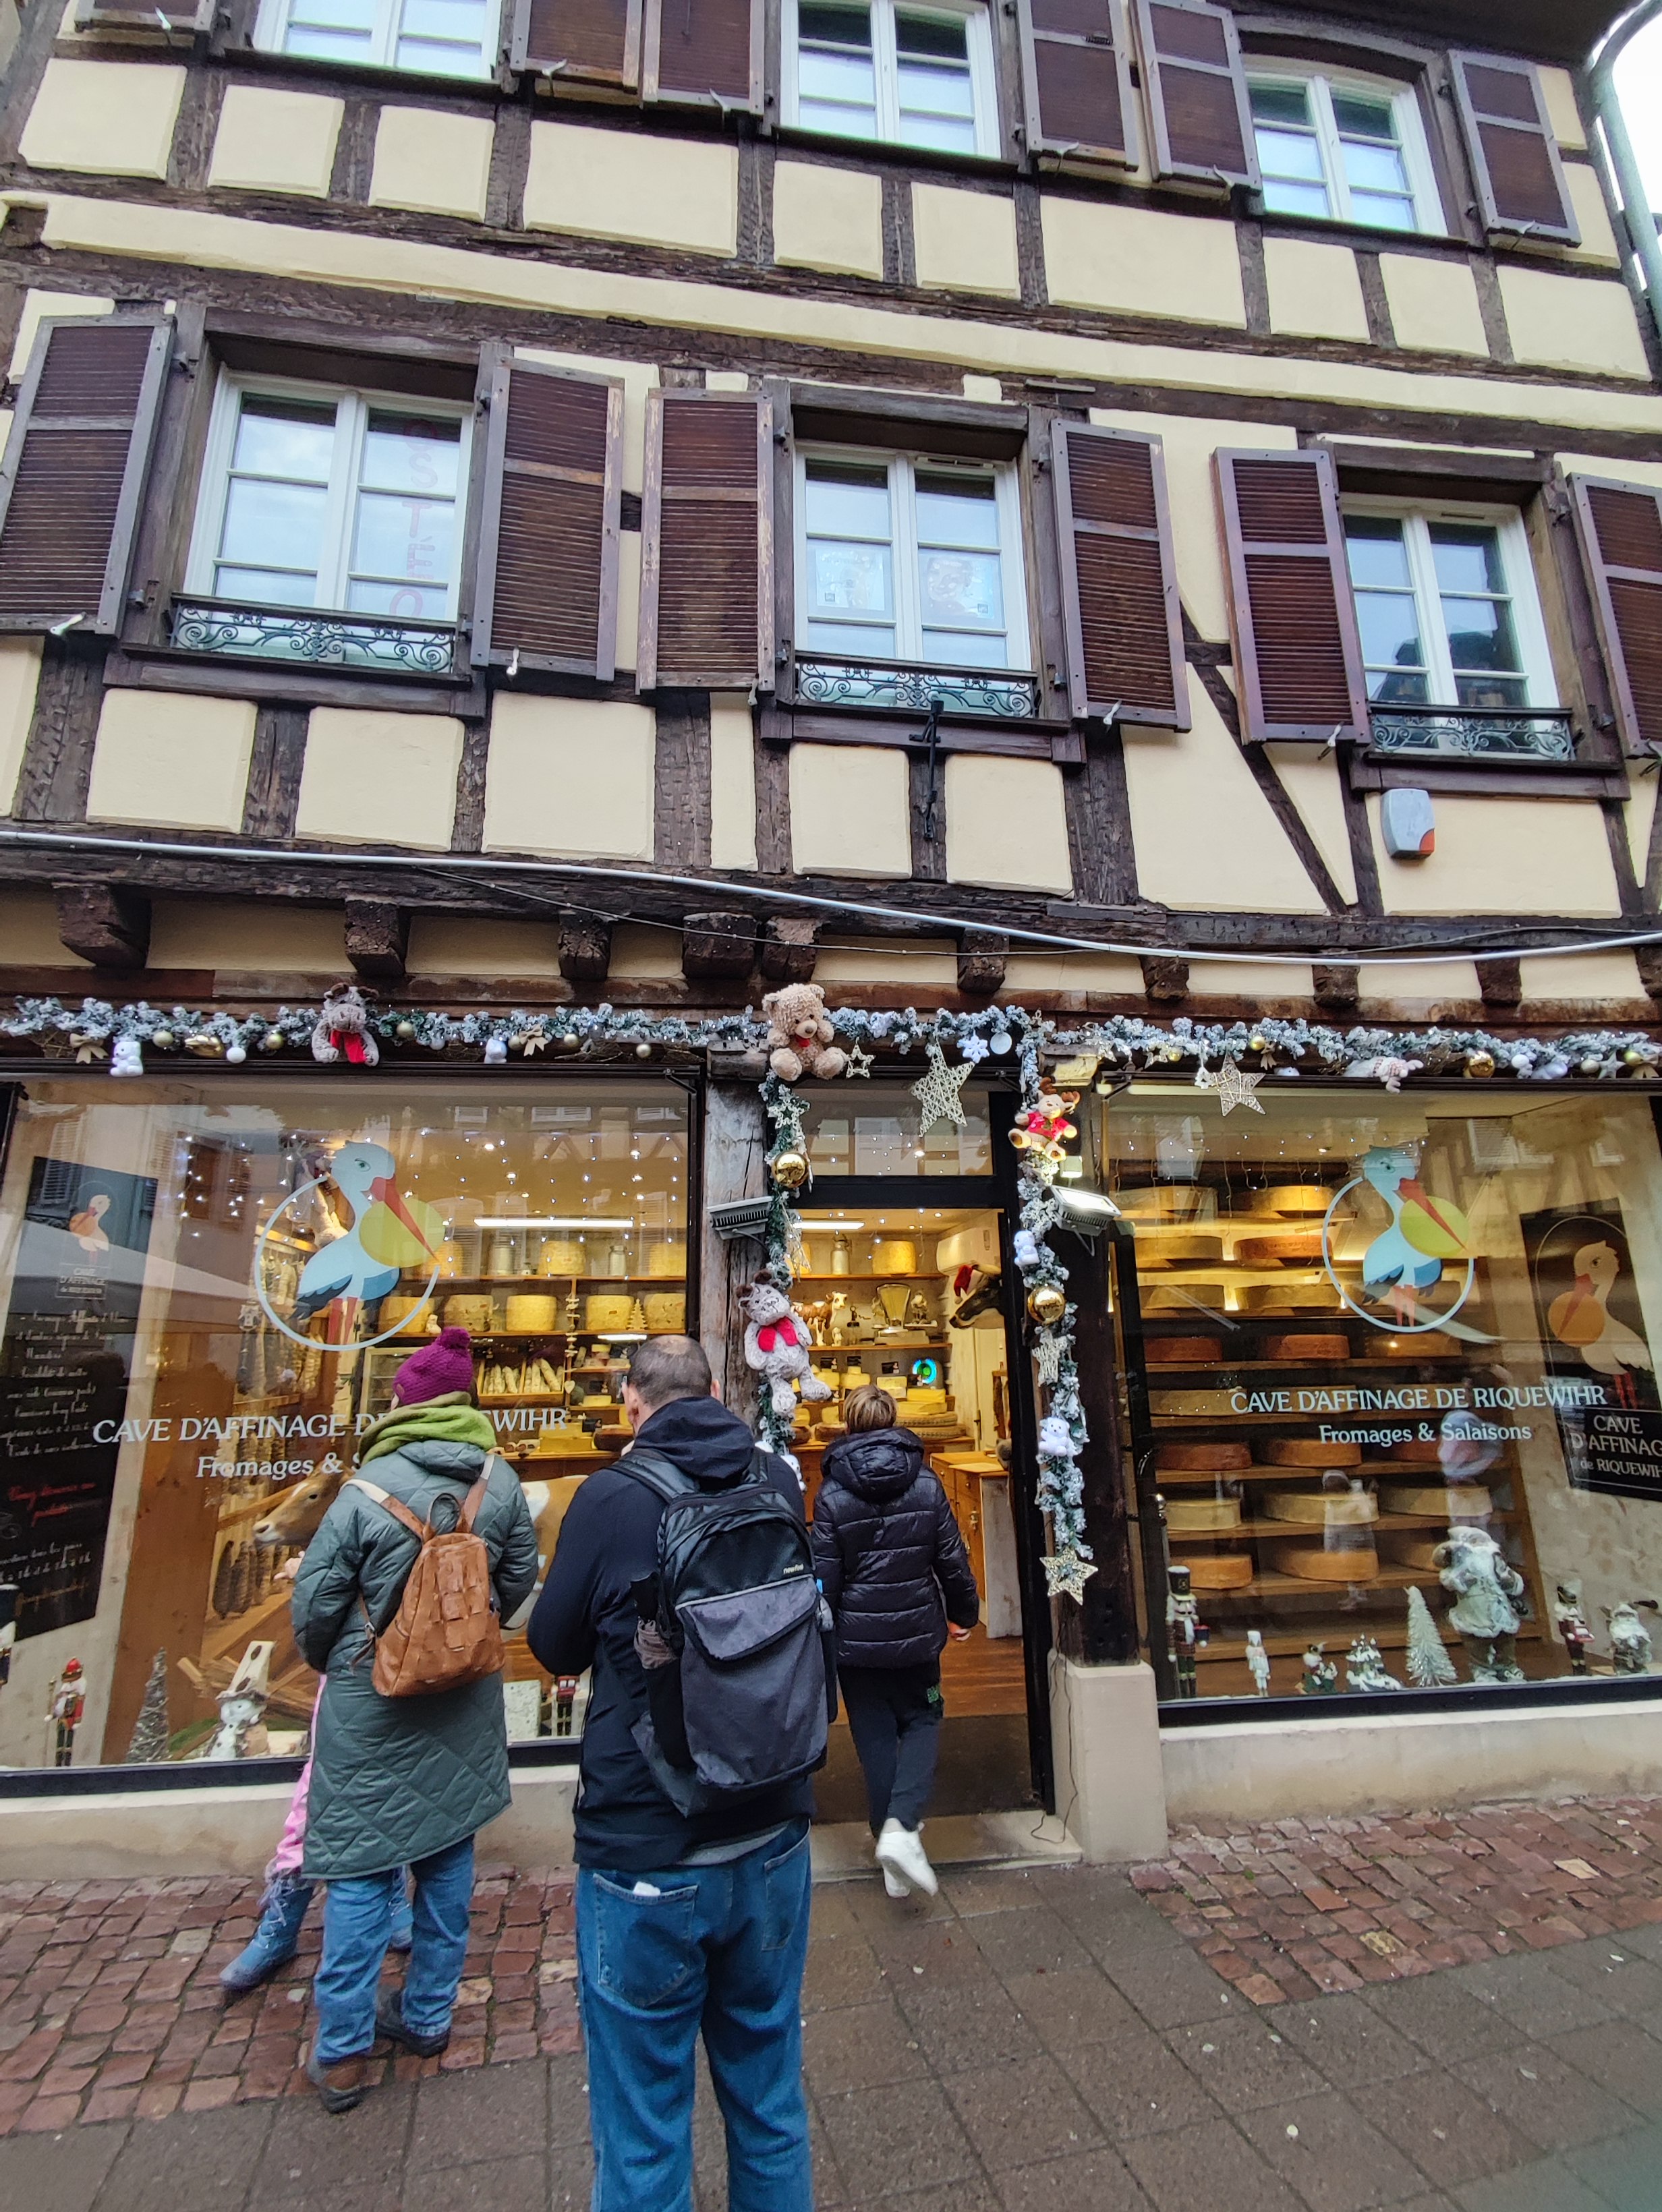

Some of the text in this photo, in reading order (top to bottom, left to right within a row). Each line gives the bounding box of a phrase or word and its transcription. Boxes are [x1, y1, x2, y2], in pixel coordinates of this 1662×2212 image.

[1230, 1385, 1608, 1414] CAVE D'AFFINAGE DE RIQUEWIHR
[93, 1418, 171, 1443] CAVE
[179, 1414, 347, 1441] D'AFFINAGE
[354, 1413, 389, 1436] D
[1319, 1422, 1532, 1447] Fromages & Salaisons
[1593, 1415, 1644, 1434] CAVE
[1570, 1432, 1662, 1457] DAFFINAG
[196, 1455, 314, 1480] Fromages
[321, 1452, 343, 1474] &
